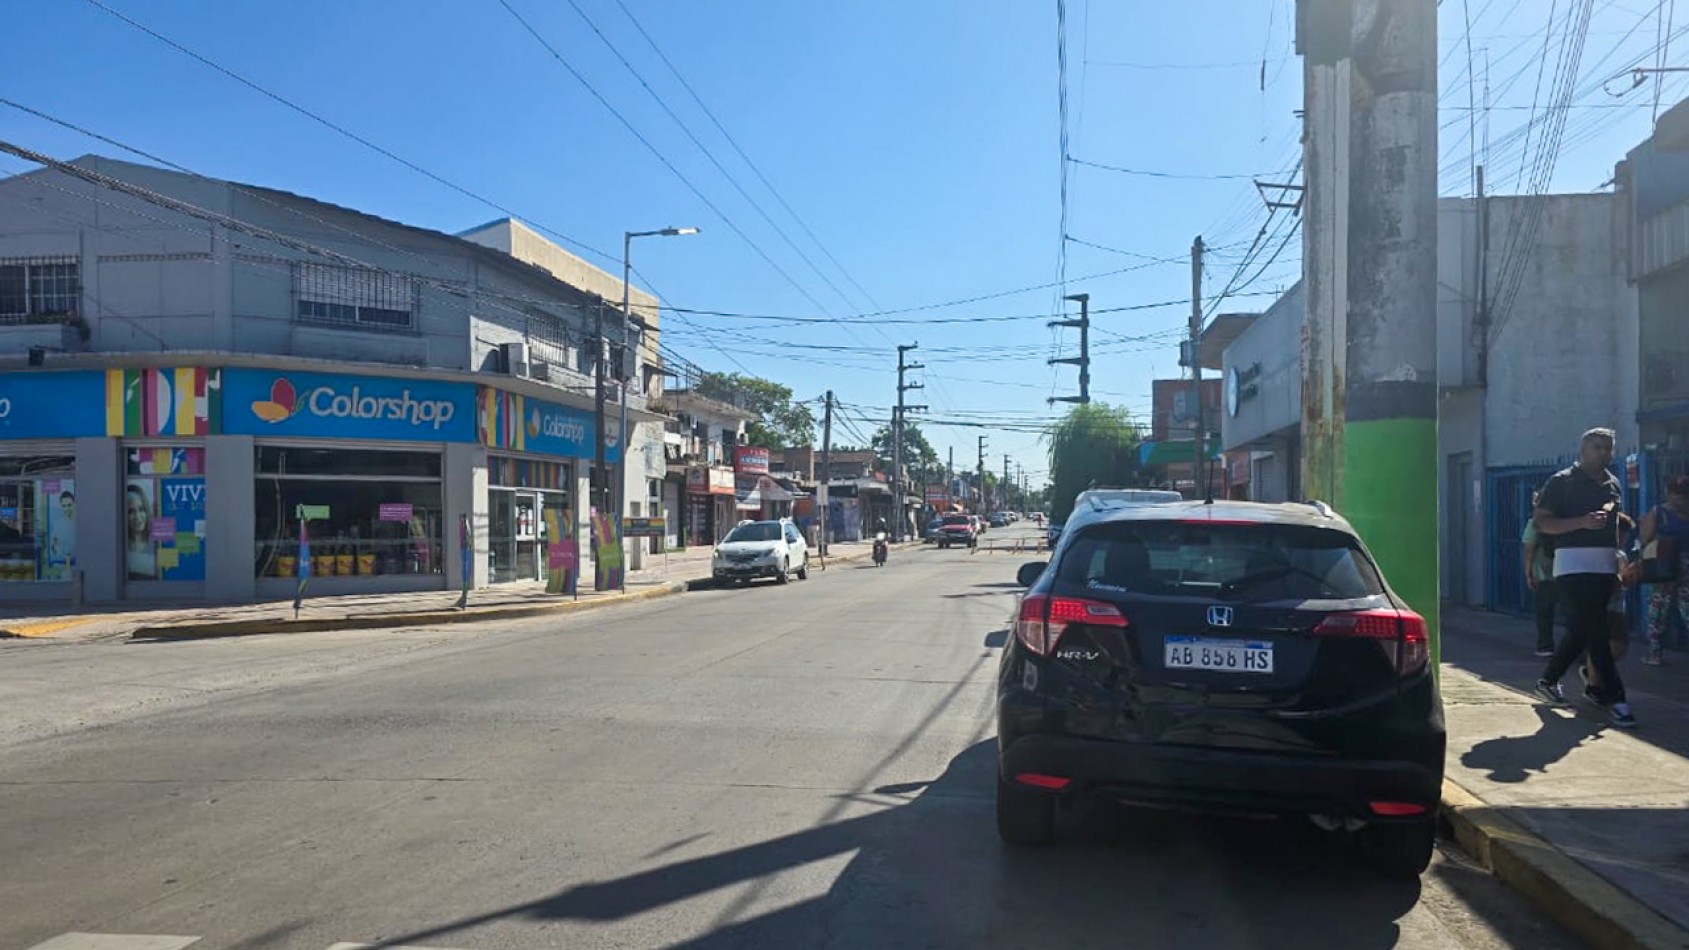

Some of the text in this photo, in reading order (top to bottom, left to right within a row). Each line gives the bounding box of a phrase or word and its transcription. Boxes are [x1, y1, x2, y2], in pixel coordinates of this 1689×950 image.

[309, 386, 455, 430] Colorshop
[543, 413, 584, 444] Colorshop
[1056, 650, 1099, 660] HR-V
[1171, 647, 1193, 665] AB
[1244, 650, 1268, 669] HS
